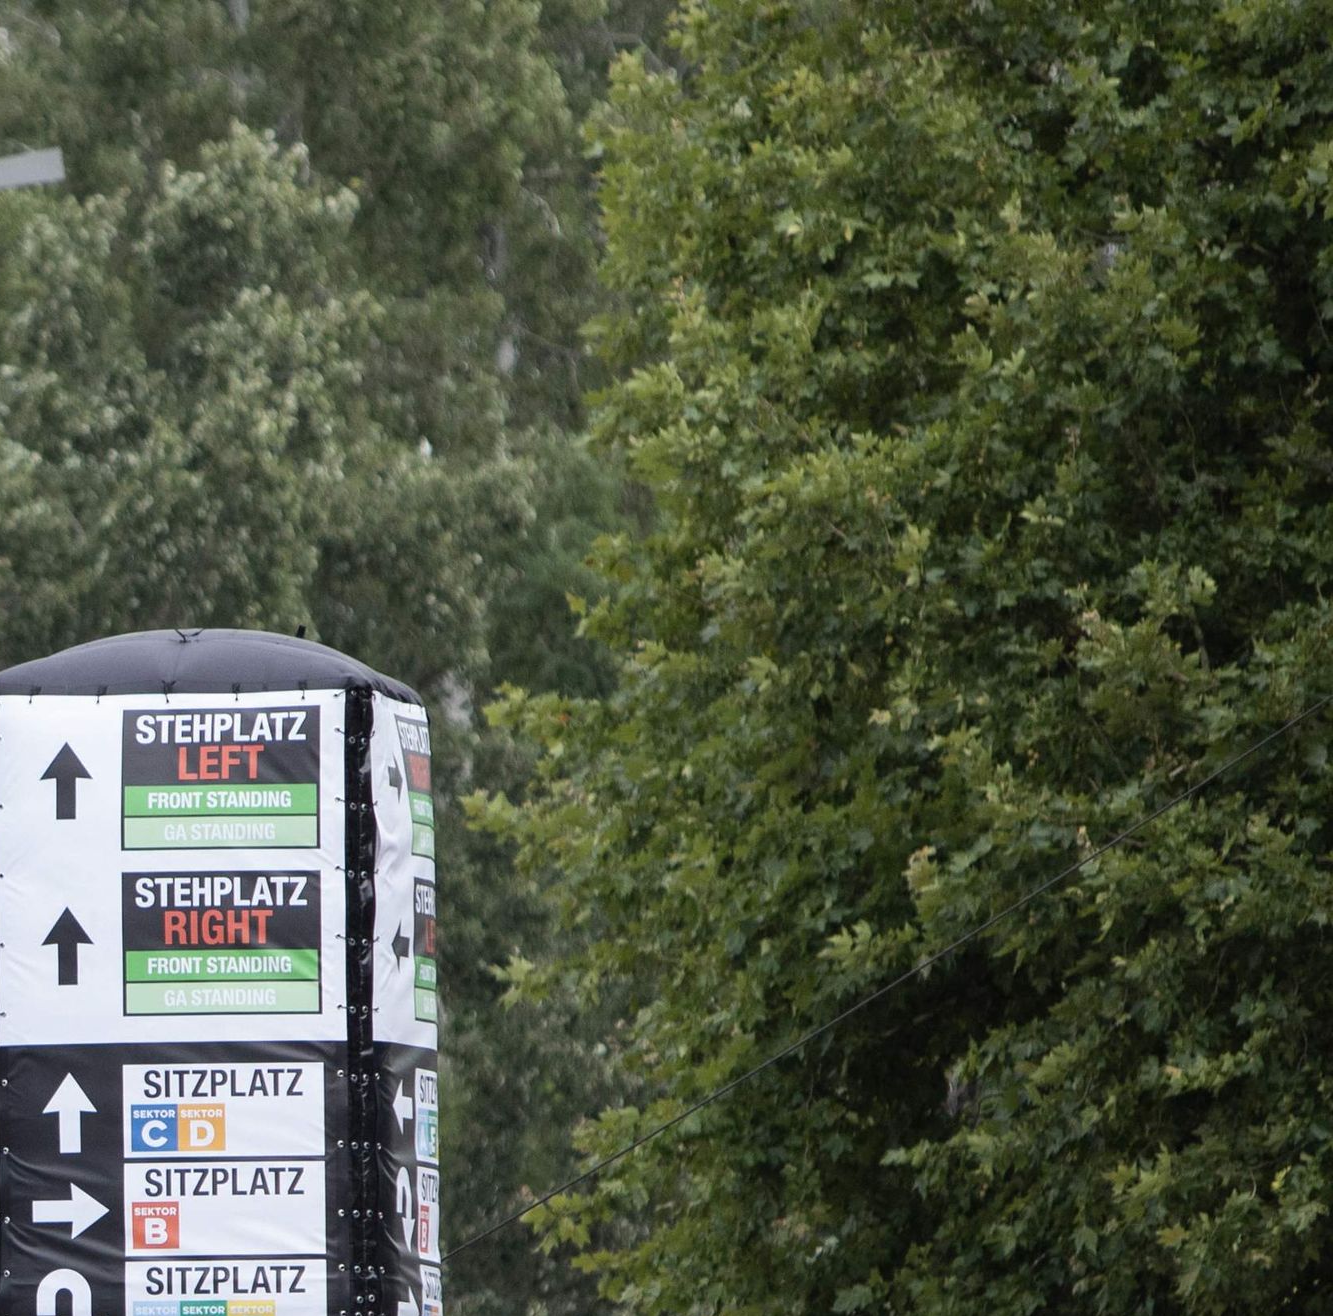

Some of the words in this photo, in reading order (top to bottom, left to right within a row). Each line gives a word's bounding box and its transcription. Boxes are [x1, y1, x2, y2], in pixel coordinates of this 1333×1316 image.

[135, 711, 307, 744] STEHPLATZ
[177, 745, 264, 781] LEFT
[147, 791, 202, 809] FRONT
[206, 790, 292, 809] STANDING
[163, 823, 189, 841] GA
[192, 822, 275, 841] STANDING
[135, 876, 308, 908] STEHPLATZ
[163, 909, 274, 945] RIGHT
[147, 957, 202, 975] FRONT
[206, 956, 292, 974] STANDING
[163, 990, 189, 1007] GA
[192, 989, 276, 1007] STANDING
[143, 1069, 303, 1099] SITZPLATZ
[133, 1109, 175, 1119] SEKTOR
[180, 1108, 223, 1118] SEKTOR
[141, 1120, 169, 1148] C
[189, 1120, 212, 1147] D
[144, 1168, 305, 1198] SITZPLATZ
[134, 1206, 177, 1217] SEKTOR
[145, 1218, 168, 1245] B
[146, 1265, 306, 1295] SITZPLATZ
[135, 1306, 177, 1316] SEKTOR
[183, 1305, 225, 1315] SEKTOR
[230, 1304, 273, 1315] SEKTOR
